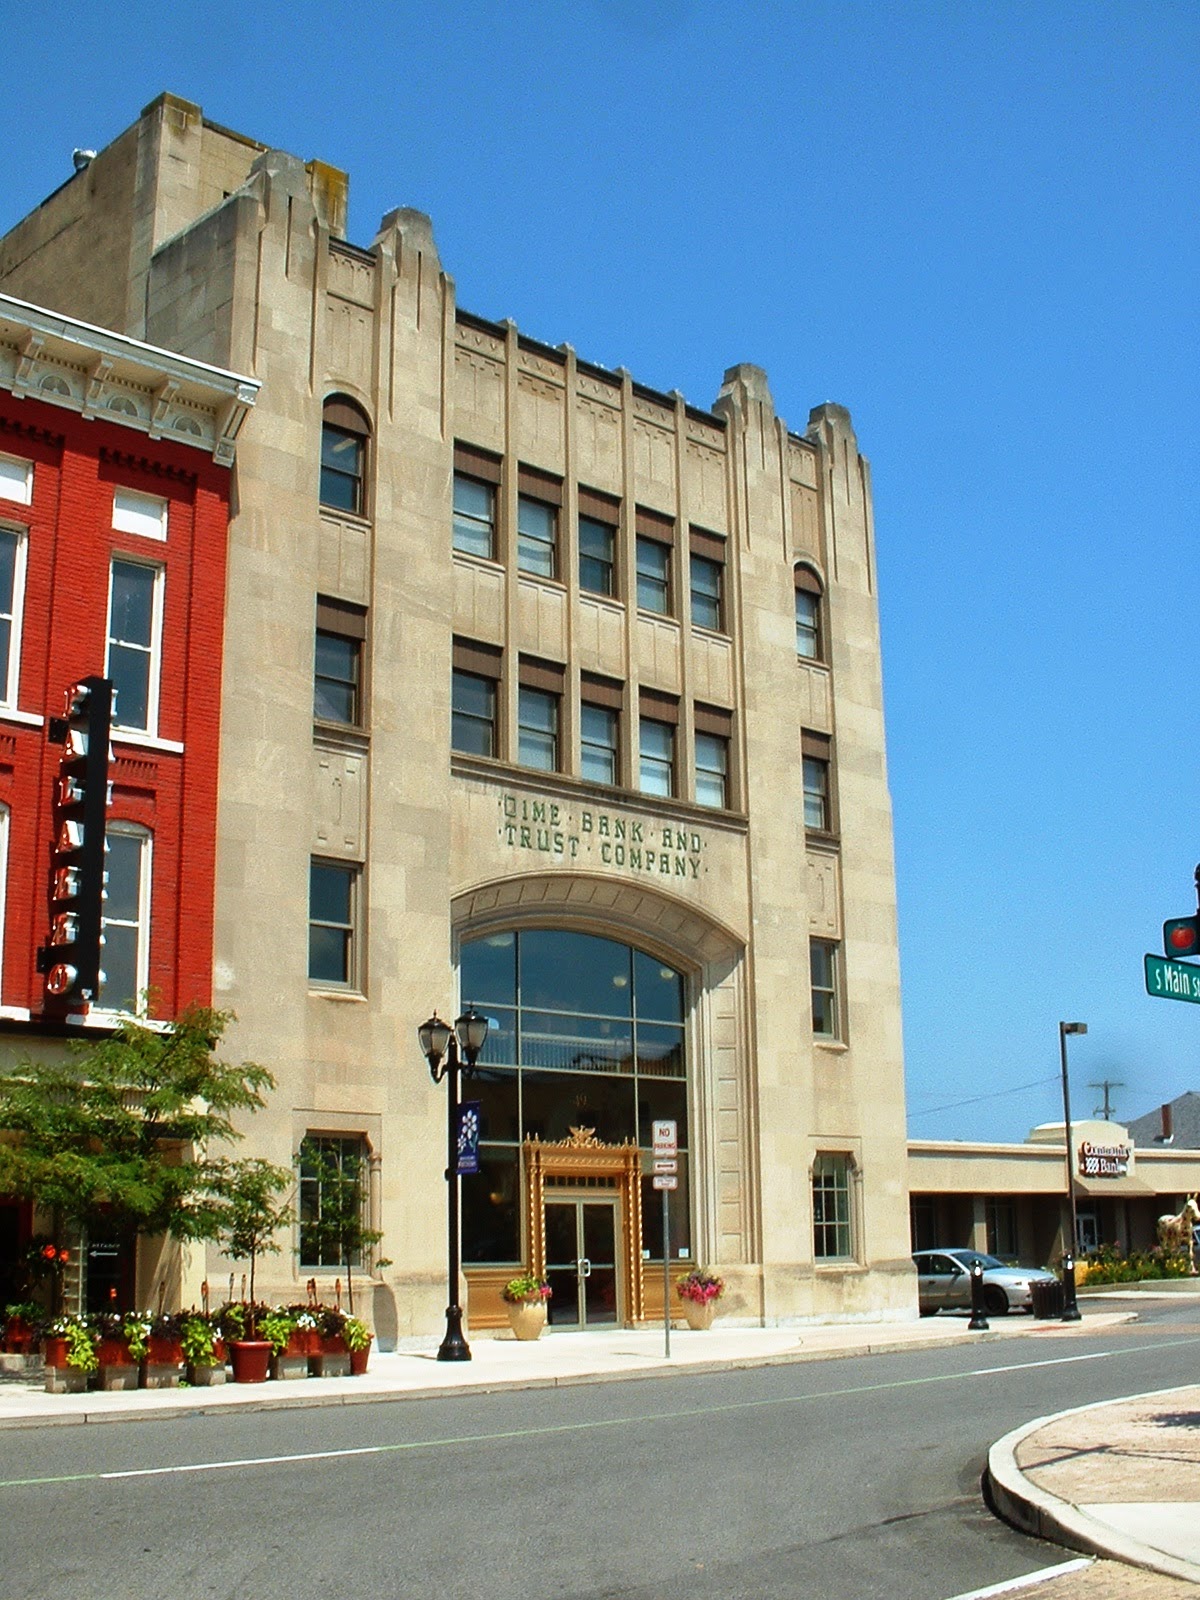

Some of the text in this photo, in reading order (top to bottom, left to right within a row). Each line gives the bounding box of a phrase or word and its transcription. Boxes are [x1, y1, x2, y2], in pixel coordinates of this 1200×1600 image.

[504, 795, 701, 853] DIME BANK AND
[505, 824, 702, 878] TRUST COMPANY
[1155, 969, 1162, 990] S
[1163, 964, 1190, 995] Main
[658, 1128, 670, 1137] NO
